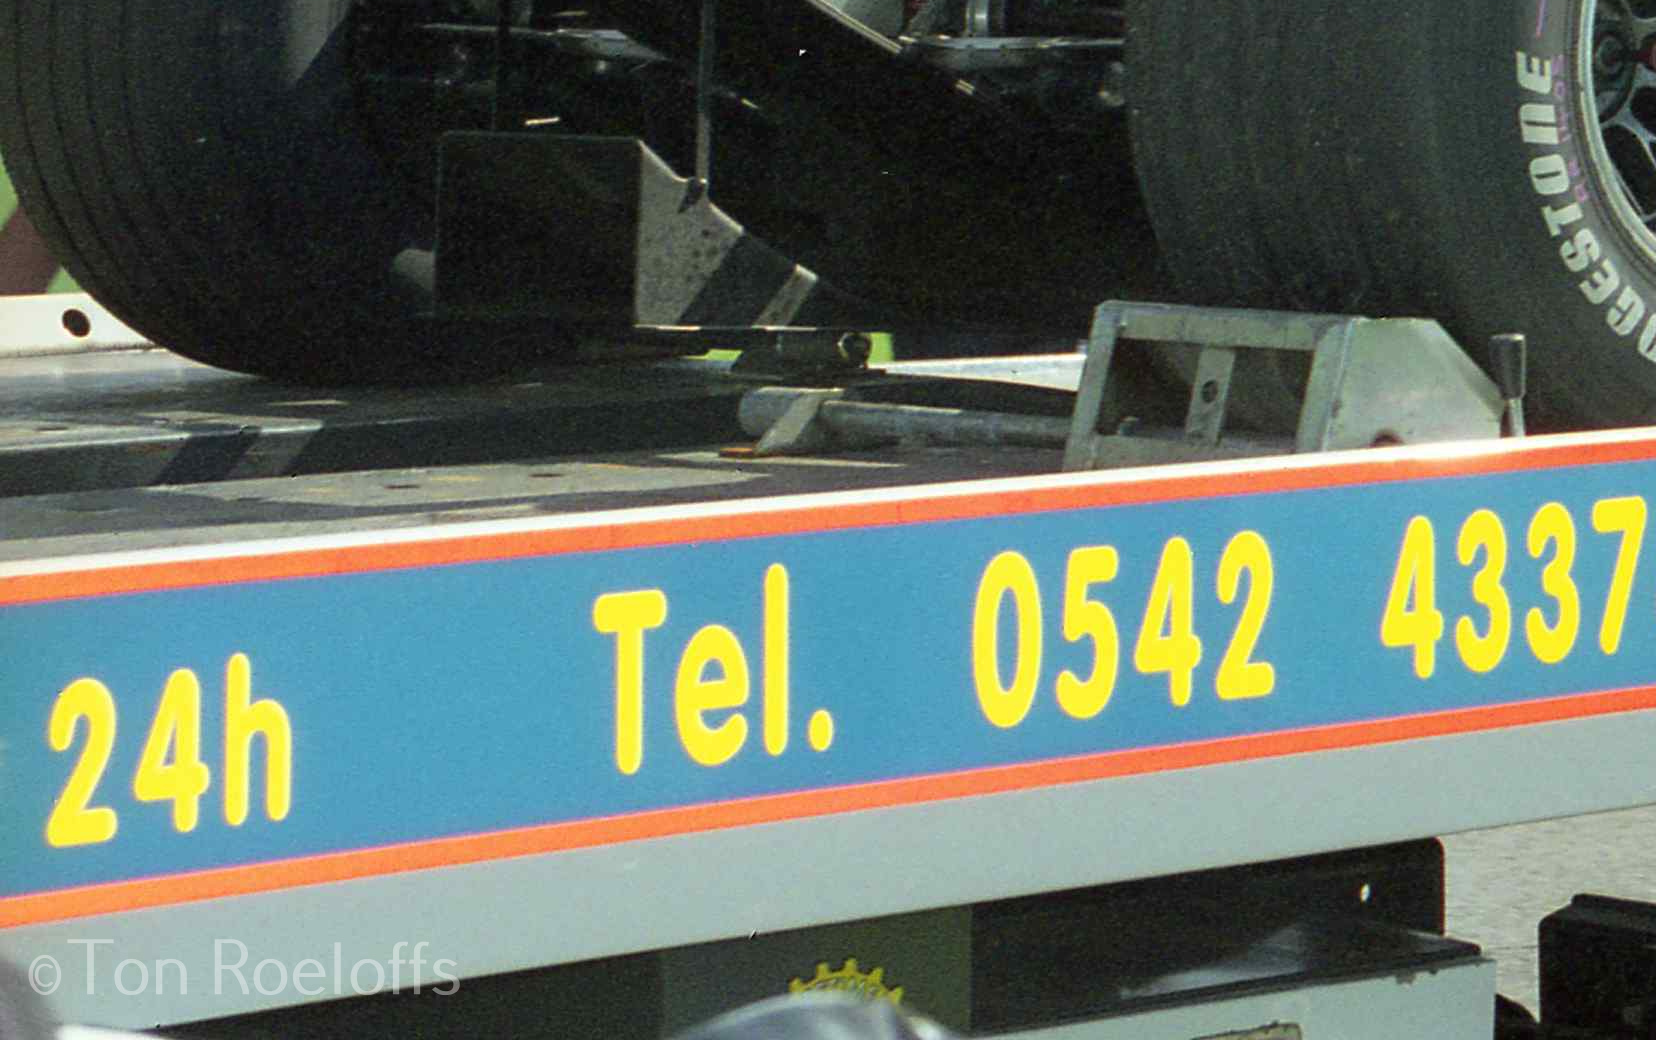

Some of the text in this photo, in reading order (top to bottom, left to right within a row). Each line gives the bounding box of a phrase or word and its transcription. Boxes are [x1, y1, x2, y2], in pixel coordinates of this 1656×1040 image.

[45, 651, 292, 848] 24h
[592, 562, 835, 775] Tel.
[971, 529, 1276, 728] 0542
